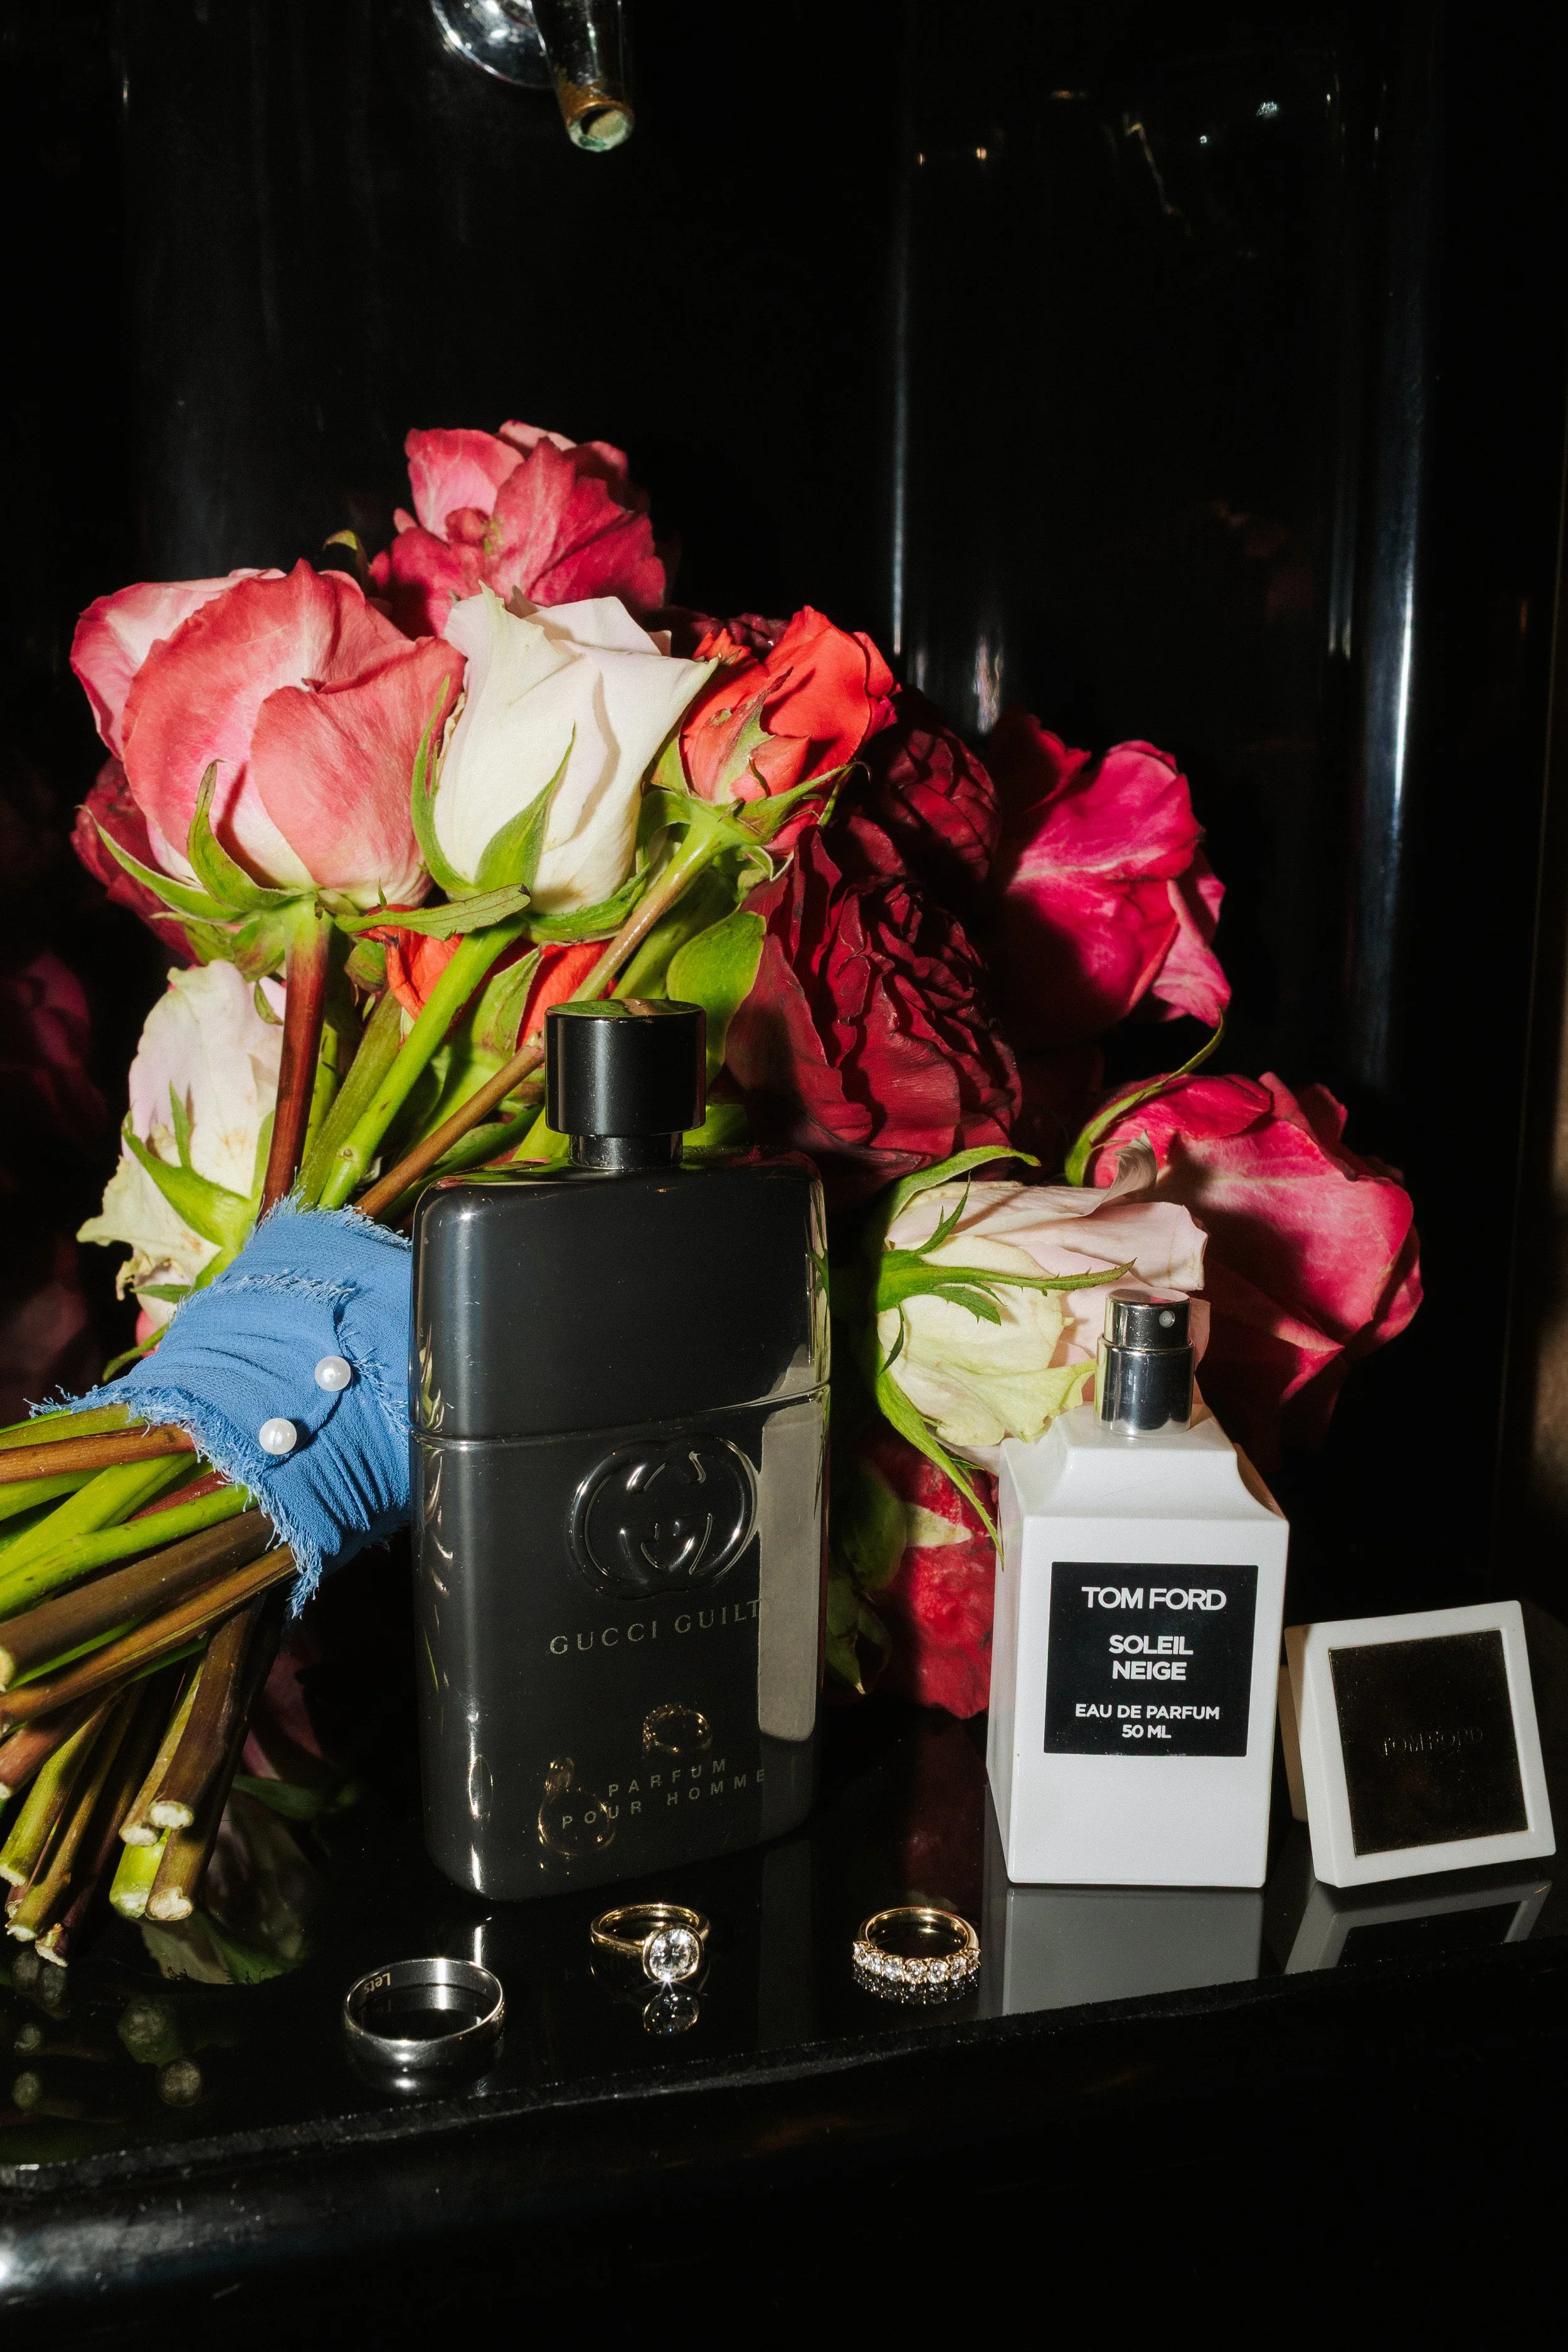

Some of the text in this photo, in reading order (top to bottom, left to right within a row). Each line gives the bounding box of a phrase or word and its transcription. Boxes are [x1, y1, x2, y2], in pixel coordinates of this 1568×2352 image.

[1081, 1586, 1227, 1611] TOM FORD
[549, 1598, 773, 1655] GUCCI GUILT
[1108, 1634, 1194, 1655] SOLEIL
[1112, 1660, 1187, 1681] NEIGE
[1075, 1703, 1221, 1720] EAU DE PARFUM
[1121, 1724, 1172, 1739] 50 ML
[608, 1758, 726, 1798] PARFUM
[562, 1769, 766, 1830] POUR HOMME
